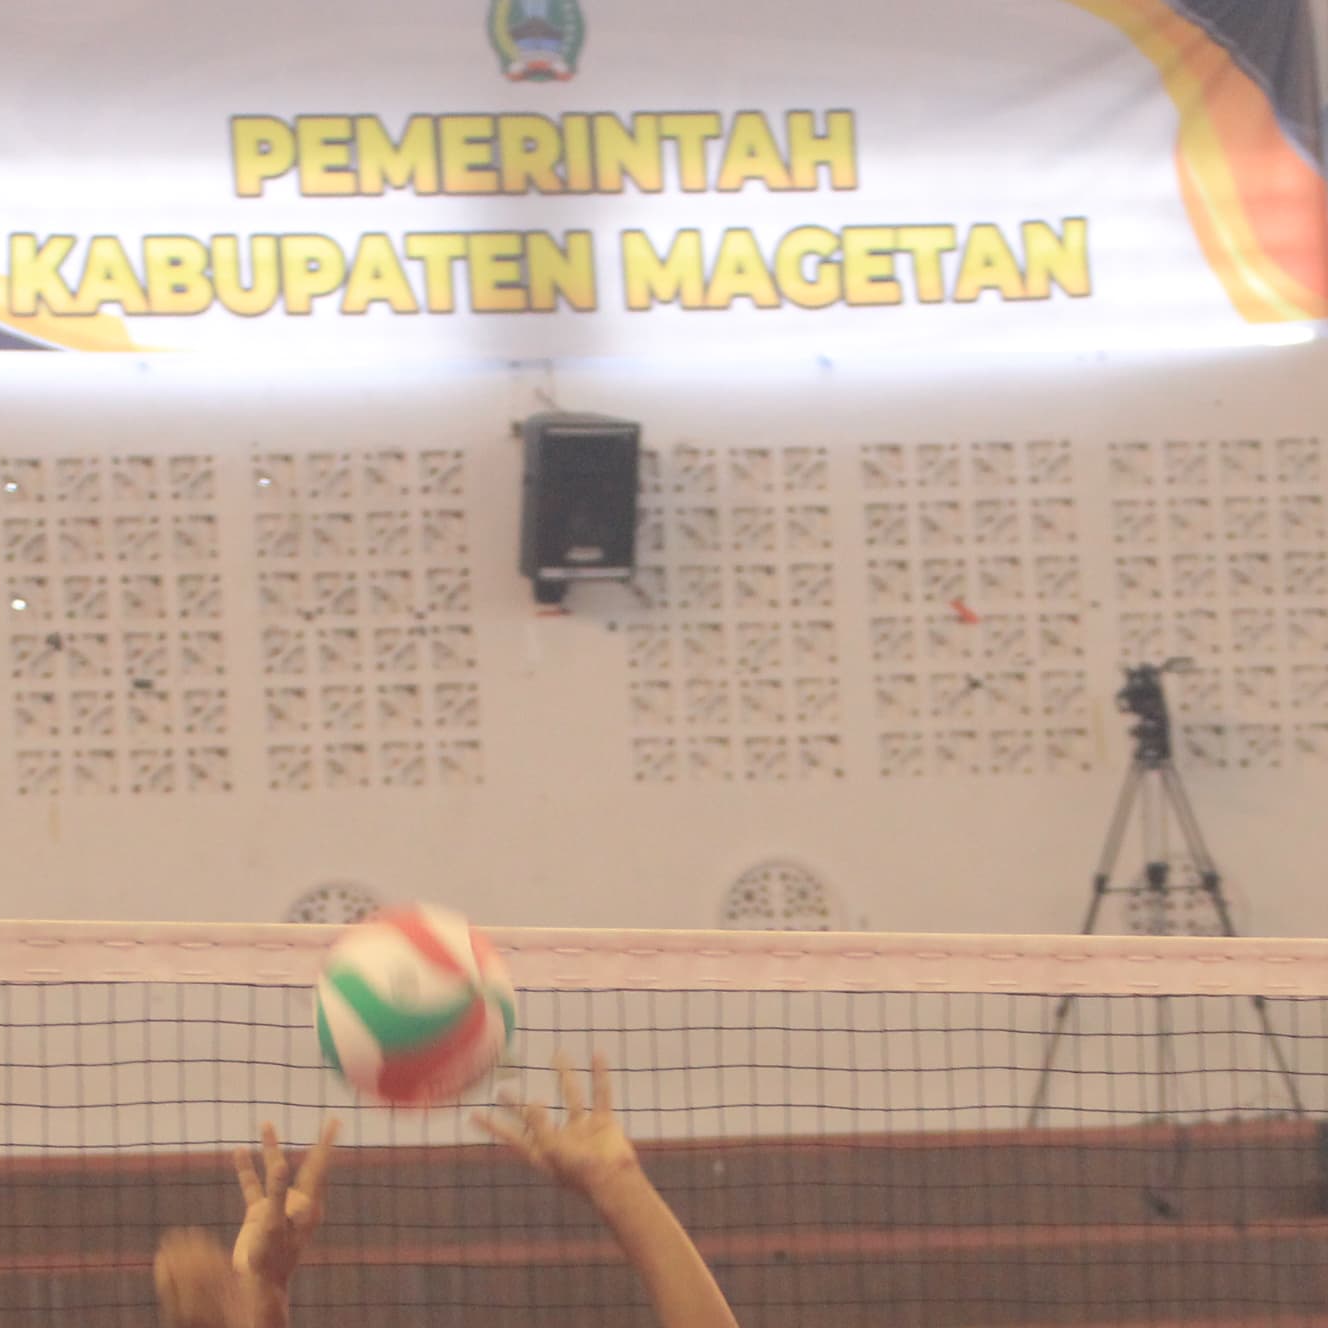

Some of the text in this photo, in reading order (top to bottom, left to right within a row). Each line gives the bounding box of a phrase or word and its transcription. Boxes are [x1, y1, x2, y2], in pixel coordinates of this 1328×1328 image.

[230, 109, 858, 197] PEMERINTAH
[8, 217, 1091, 317] KABUPATEN MAGETAN
